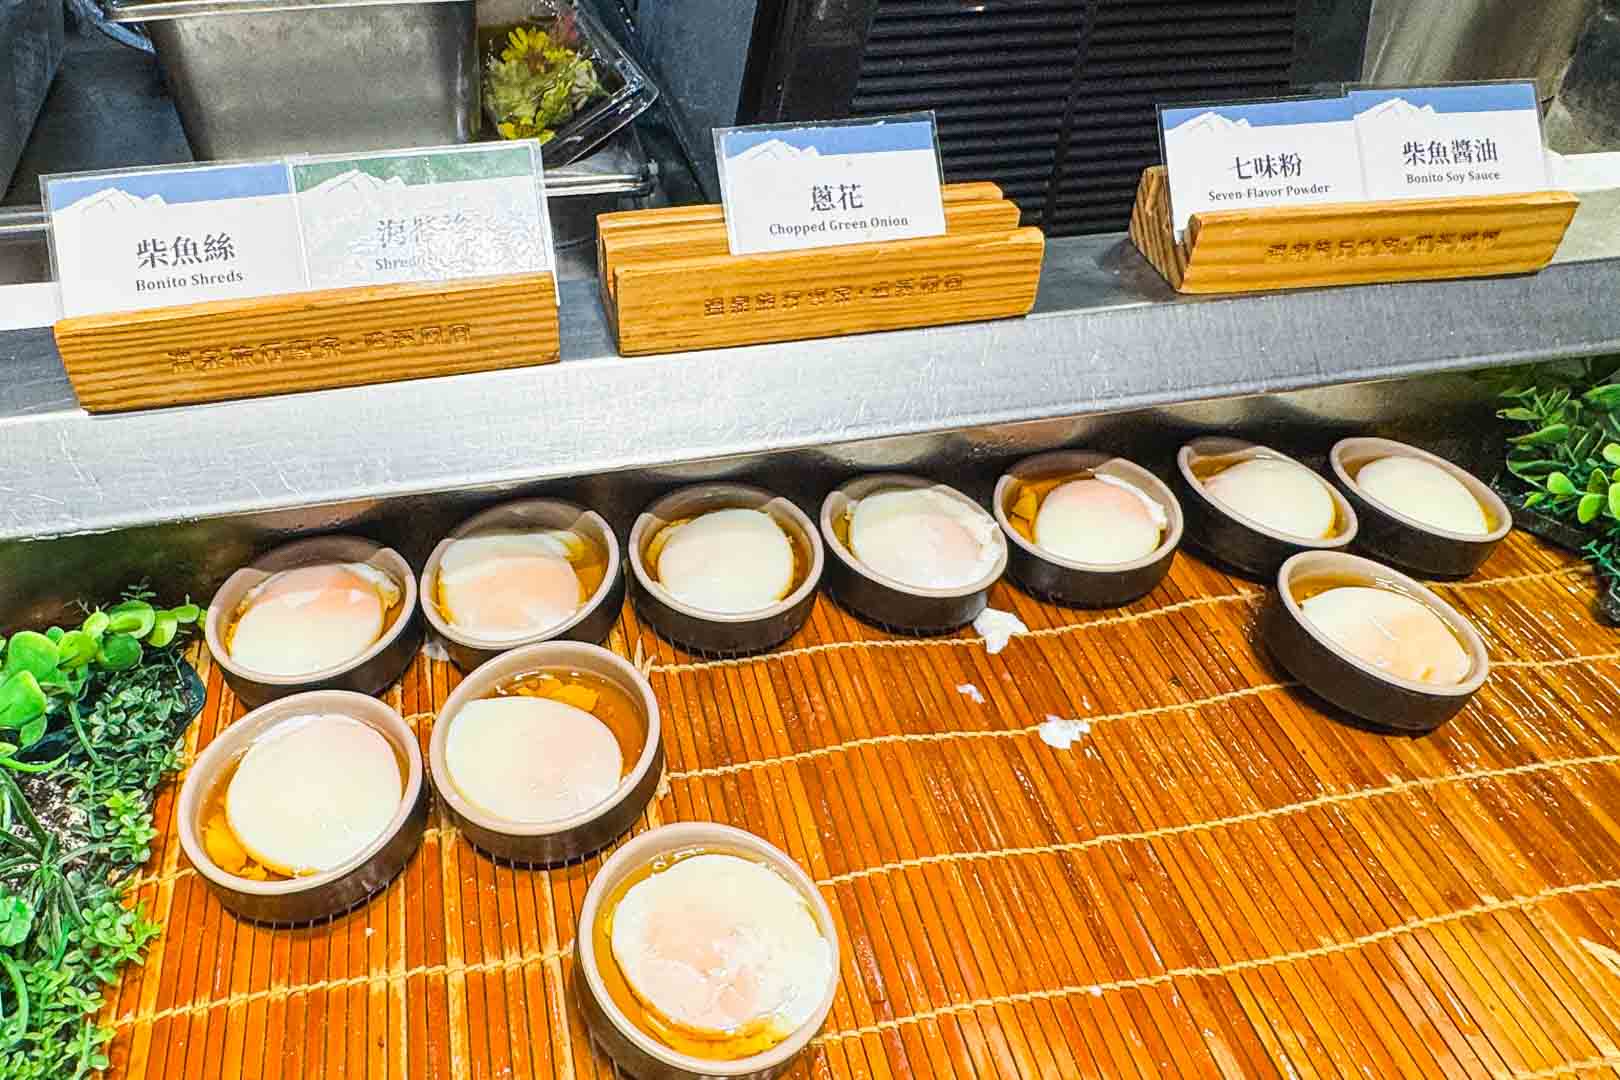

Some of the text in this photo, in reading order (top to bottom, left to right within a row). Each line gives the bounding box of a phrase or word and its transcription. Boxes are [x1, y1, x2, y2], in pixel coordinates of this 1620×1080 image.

[1402, 138, 1498, 165] 柴魚醬油
[1229, 152, 1302, 179] 七味粉
[1406, 169, 1500, 184] Bonito Soy Sauce
[1285, 182, 1329, 196] Powder
[769, 216, 909, 236] Chopped Green Onion
[136, 232, 236, 269] 柴魚絲
[136, 270, 244, 292] Bonito Shreds
